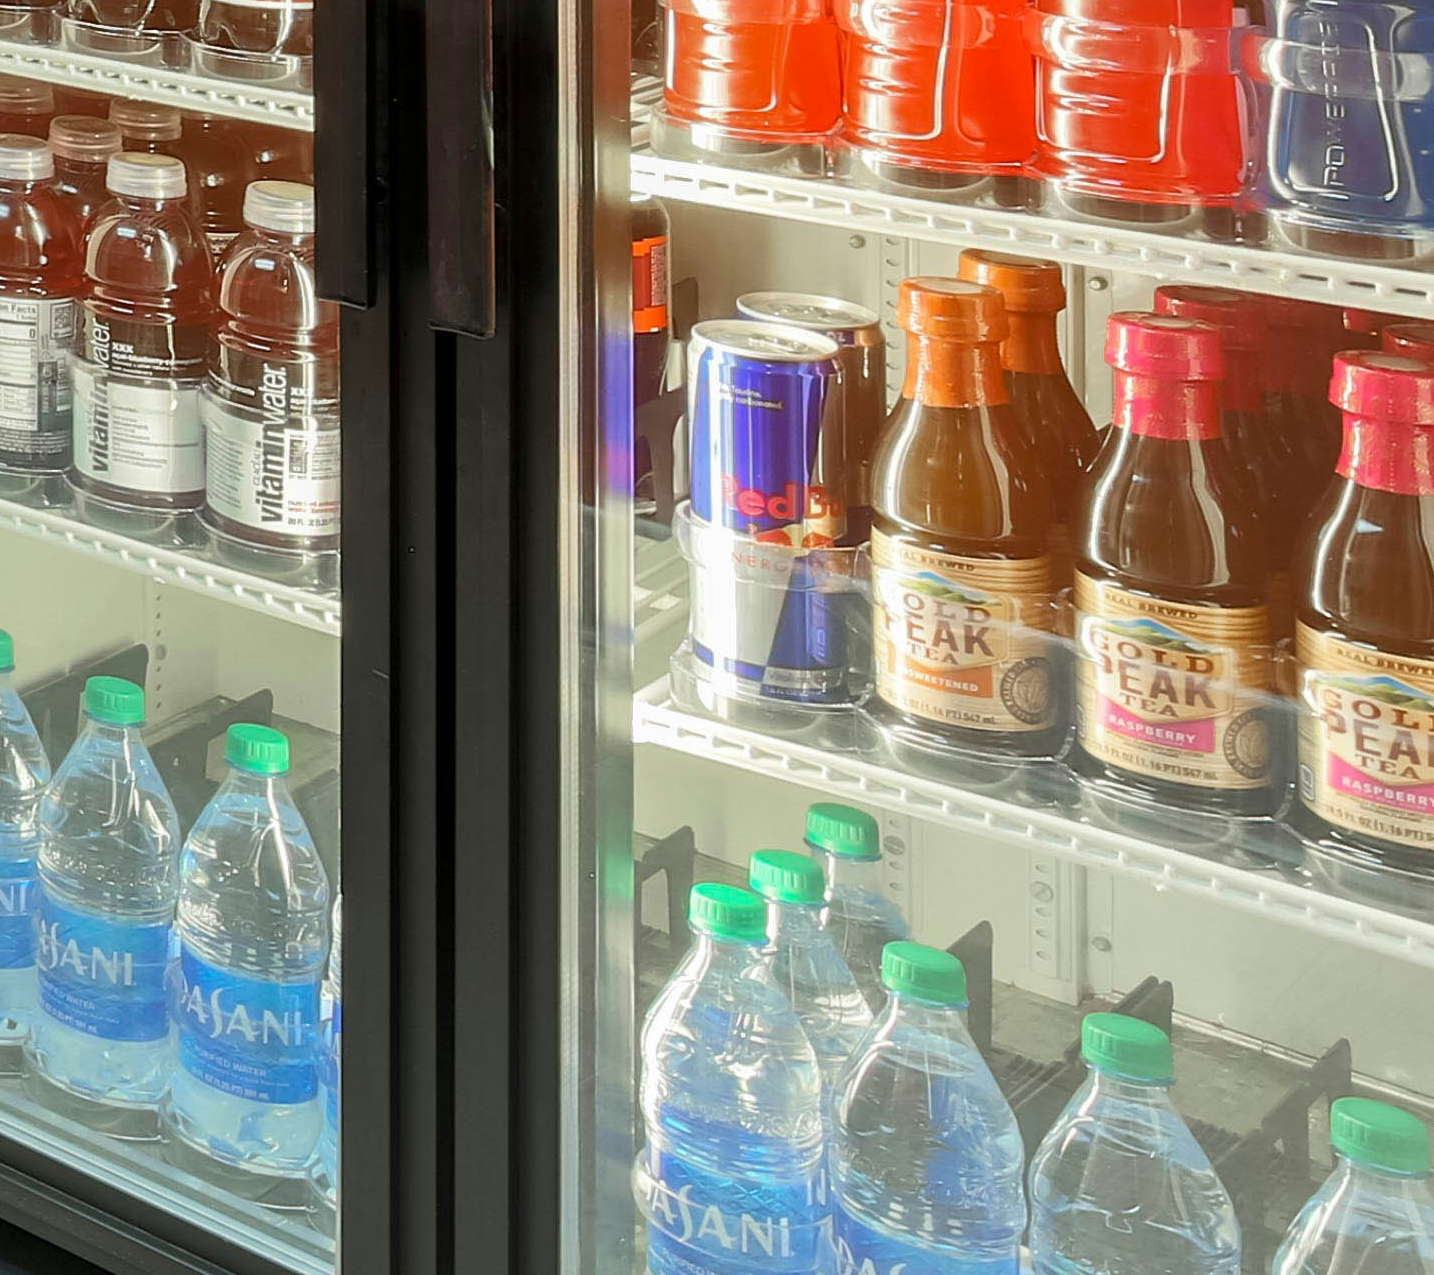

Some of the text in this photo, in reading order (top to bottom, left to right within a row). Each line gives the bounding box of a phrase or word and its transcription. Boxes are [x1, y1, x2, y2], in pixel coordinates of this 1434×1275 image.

[13, 301, 38, 315] Facts
[112, 342, 134, 354] xxx
[260, 362, 288, 525] vitaminwater
[719, 471, 795, 521] Red
[906, 642, 960, 666] TEA
[1089, 631, 1215, 675] GOLD
[1122, 693, 1179, 719] TEA
[1108, 713, 1198, 746] RASPBERRY
[1356, 755, 1420, 782] TEA
[66, 998, 97, 1010] WATER
[231, 1066, 267, 1079] WATER
